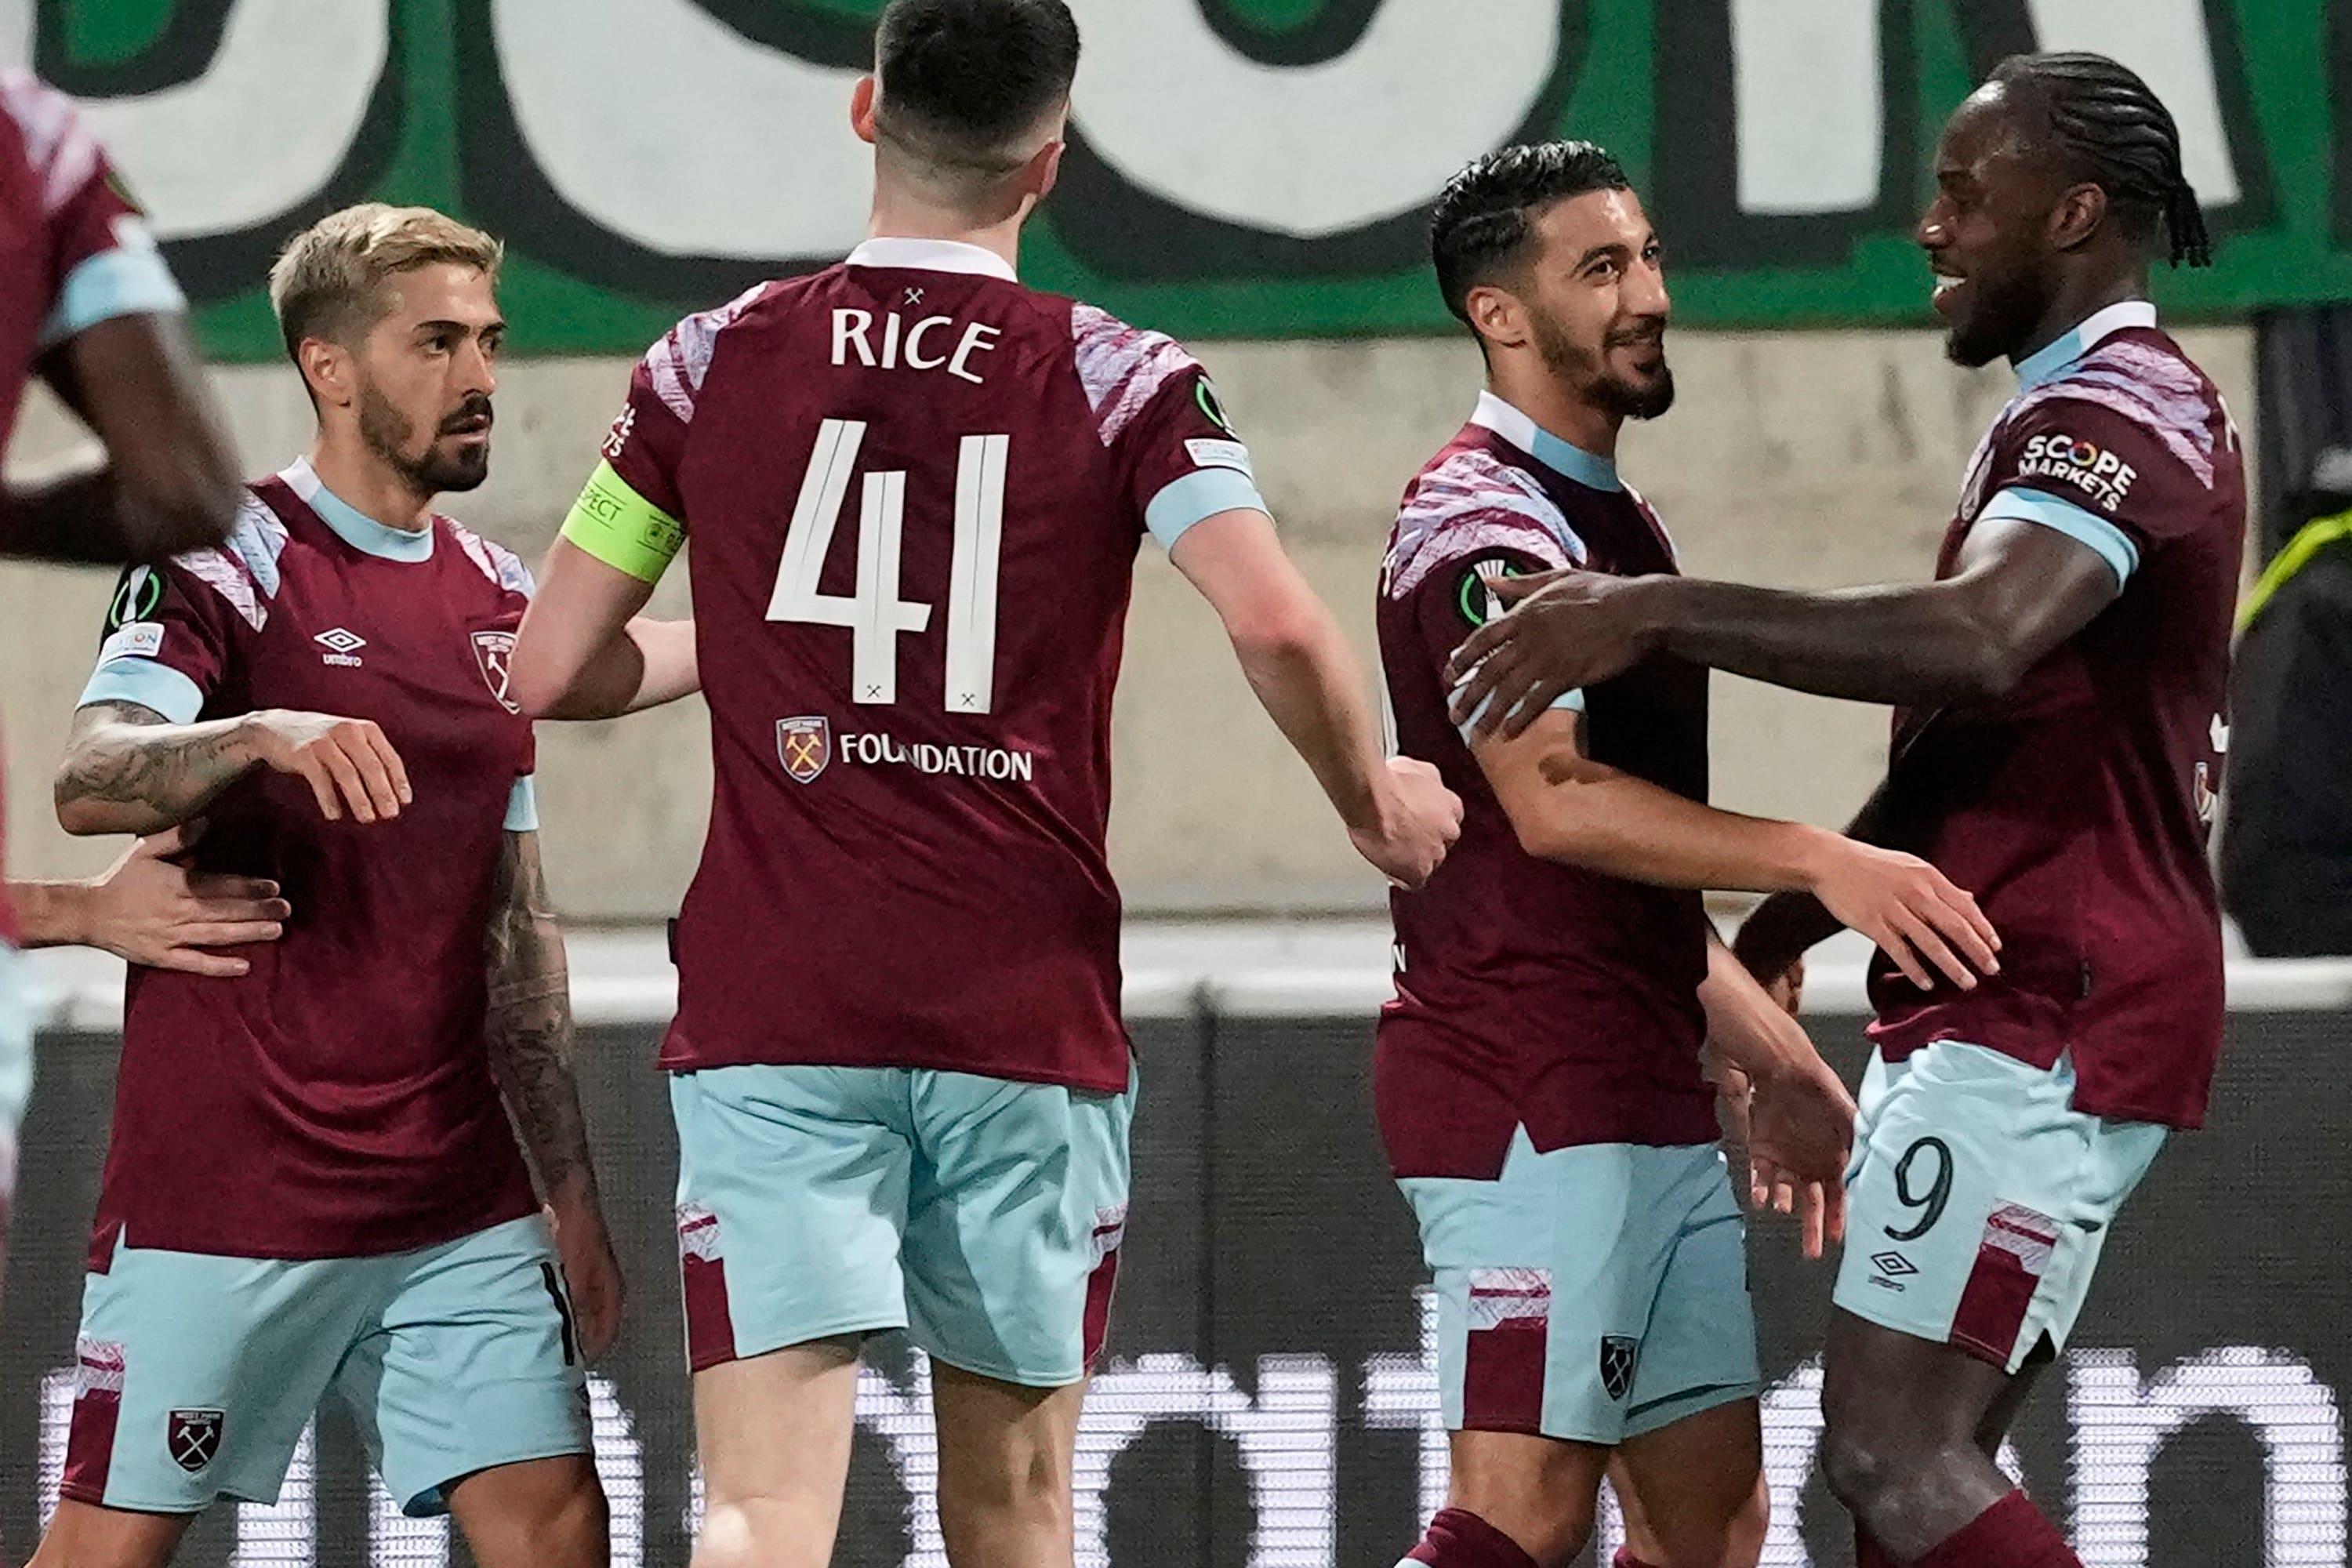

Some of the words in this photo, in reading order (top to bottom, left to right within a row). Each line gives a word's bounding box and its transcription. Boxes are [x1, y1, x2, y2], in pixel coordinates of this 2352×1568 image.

[831, 308, 1002, 384] RICE
[2018, 457, 2122, 512] MARKETS
[2023, 434, 2138, 496] SCOPE
[764, 417, 1011, 714] 41
[839, 733, 1033, 782] FOUNDATION
[1883, 1135, 1954, 1242] 9
